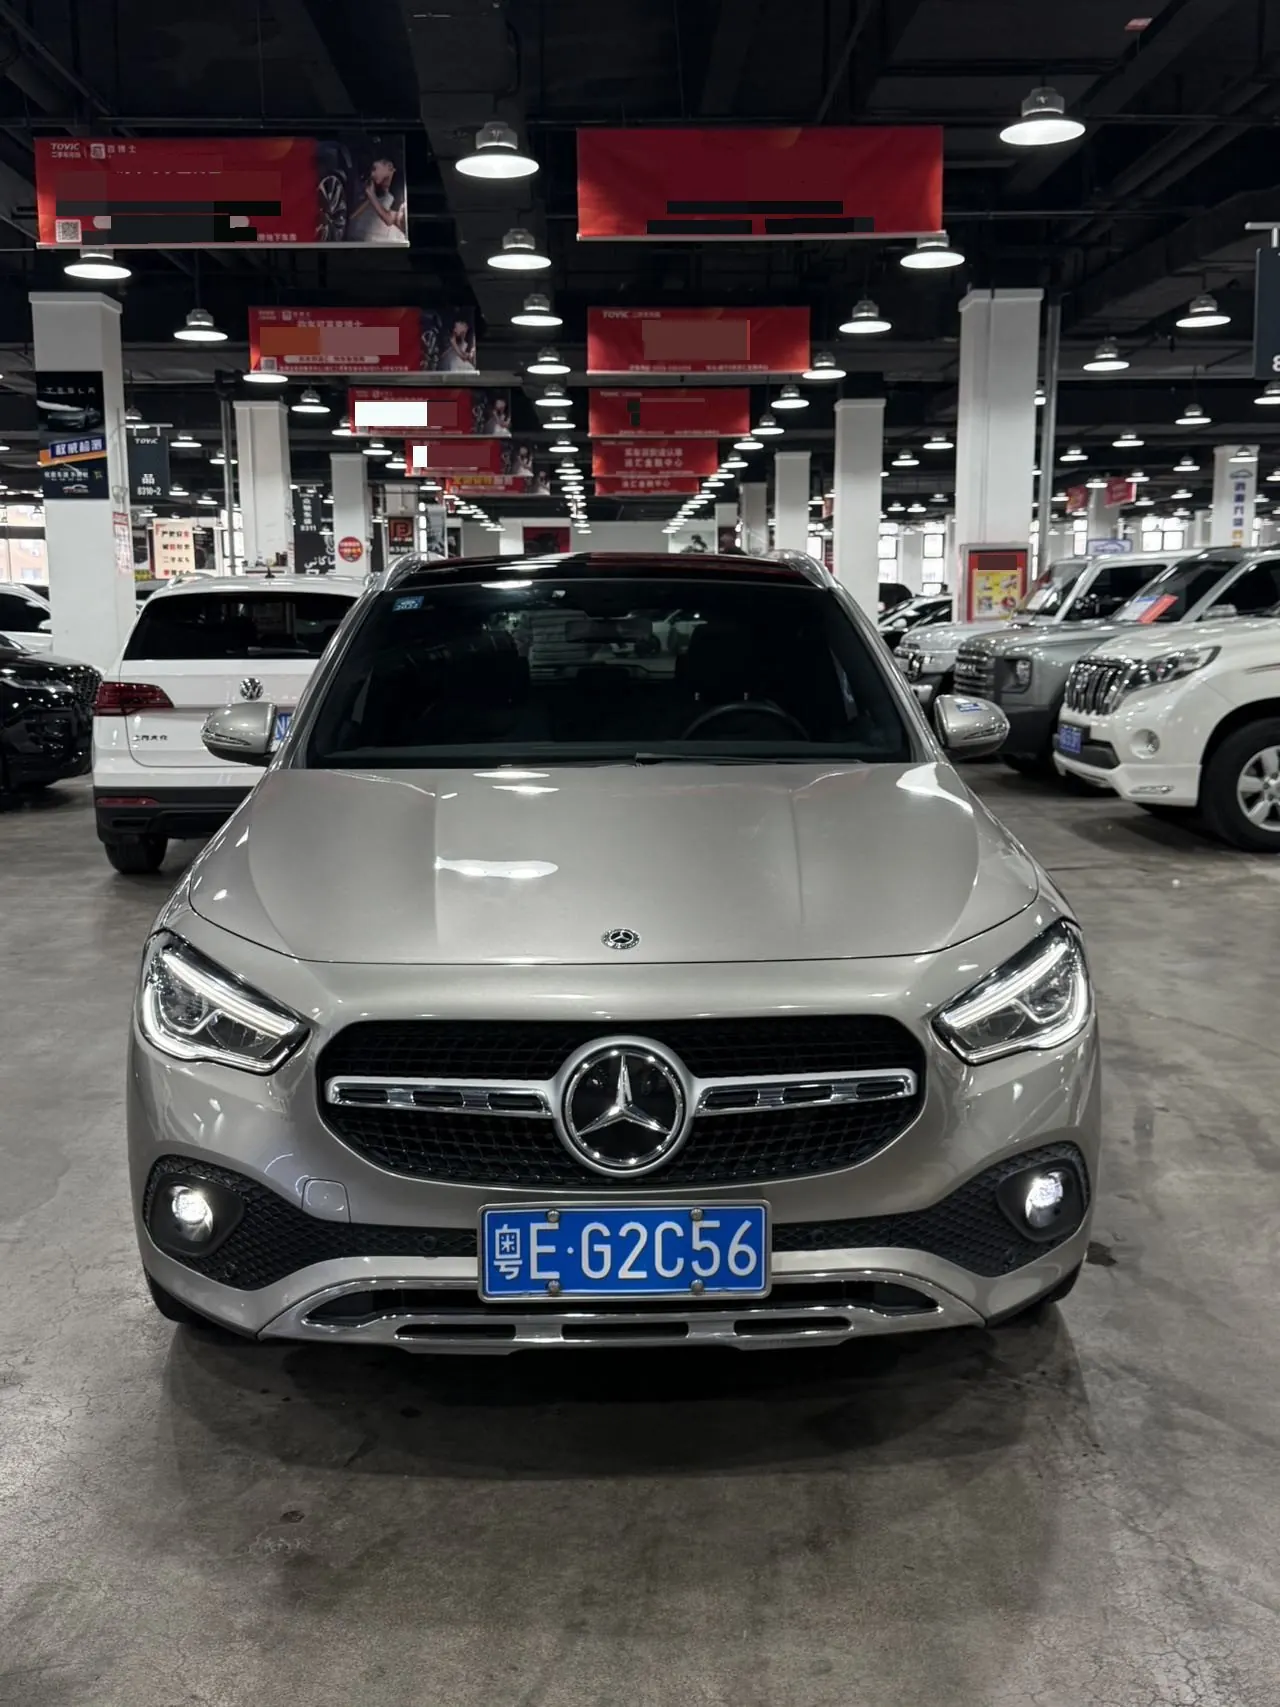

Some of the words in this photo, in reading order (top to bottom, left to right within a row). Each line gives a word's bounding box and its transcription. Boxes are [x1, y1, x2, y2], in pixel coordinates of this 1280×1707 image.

[51, 142, 80, 150] TOVIC
[45, 387, 96, 395] TESLA
[55, 438, 103, 456] 权威检测
